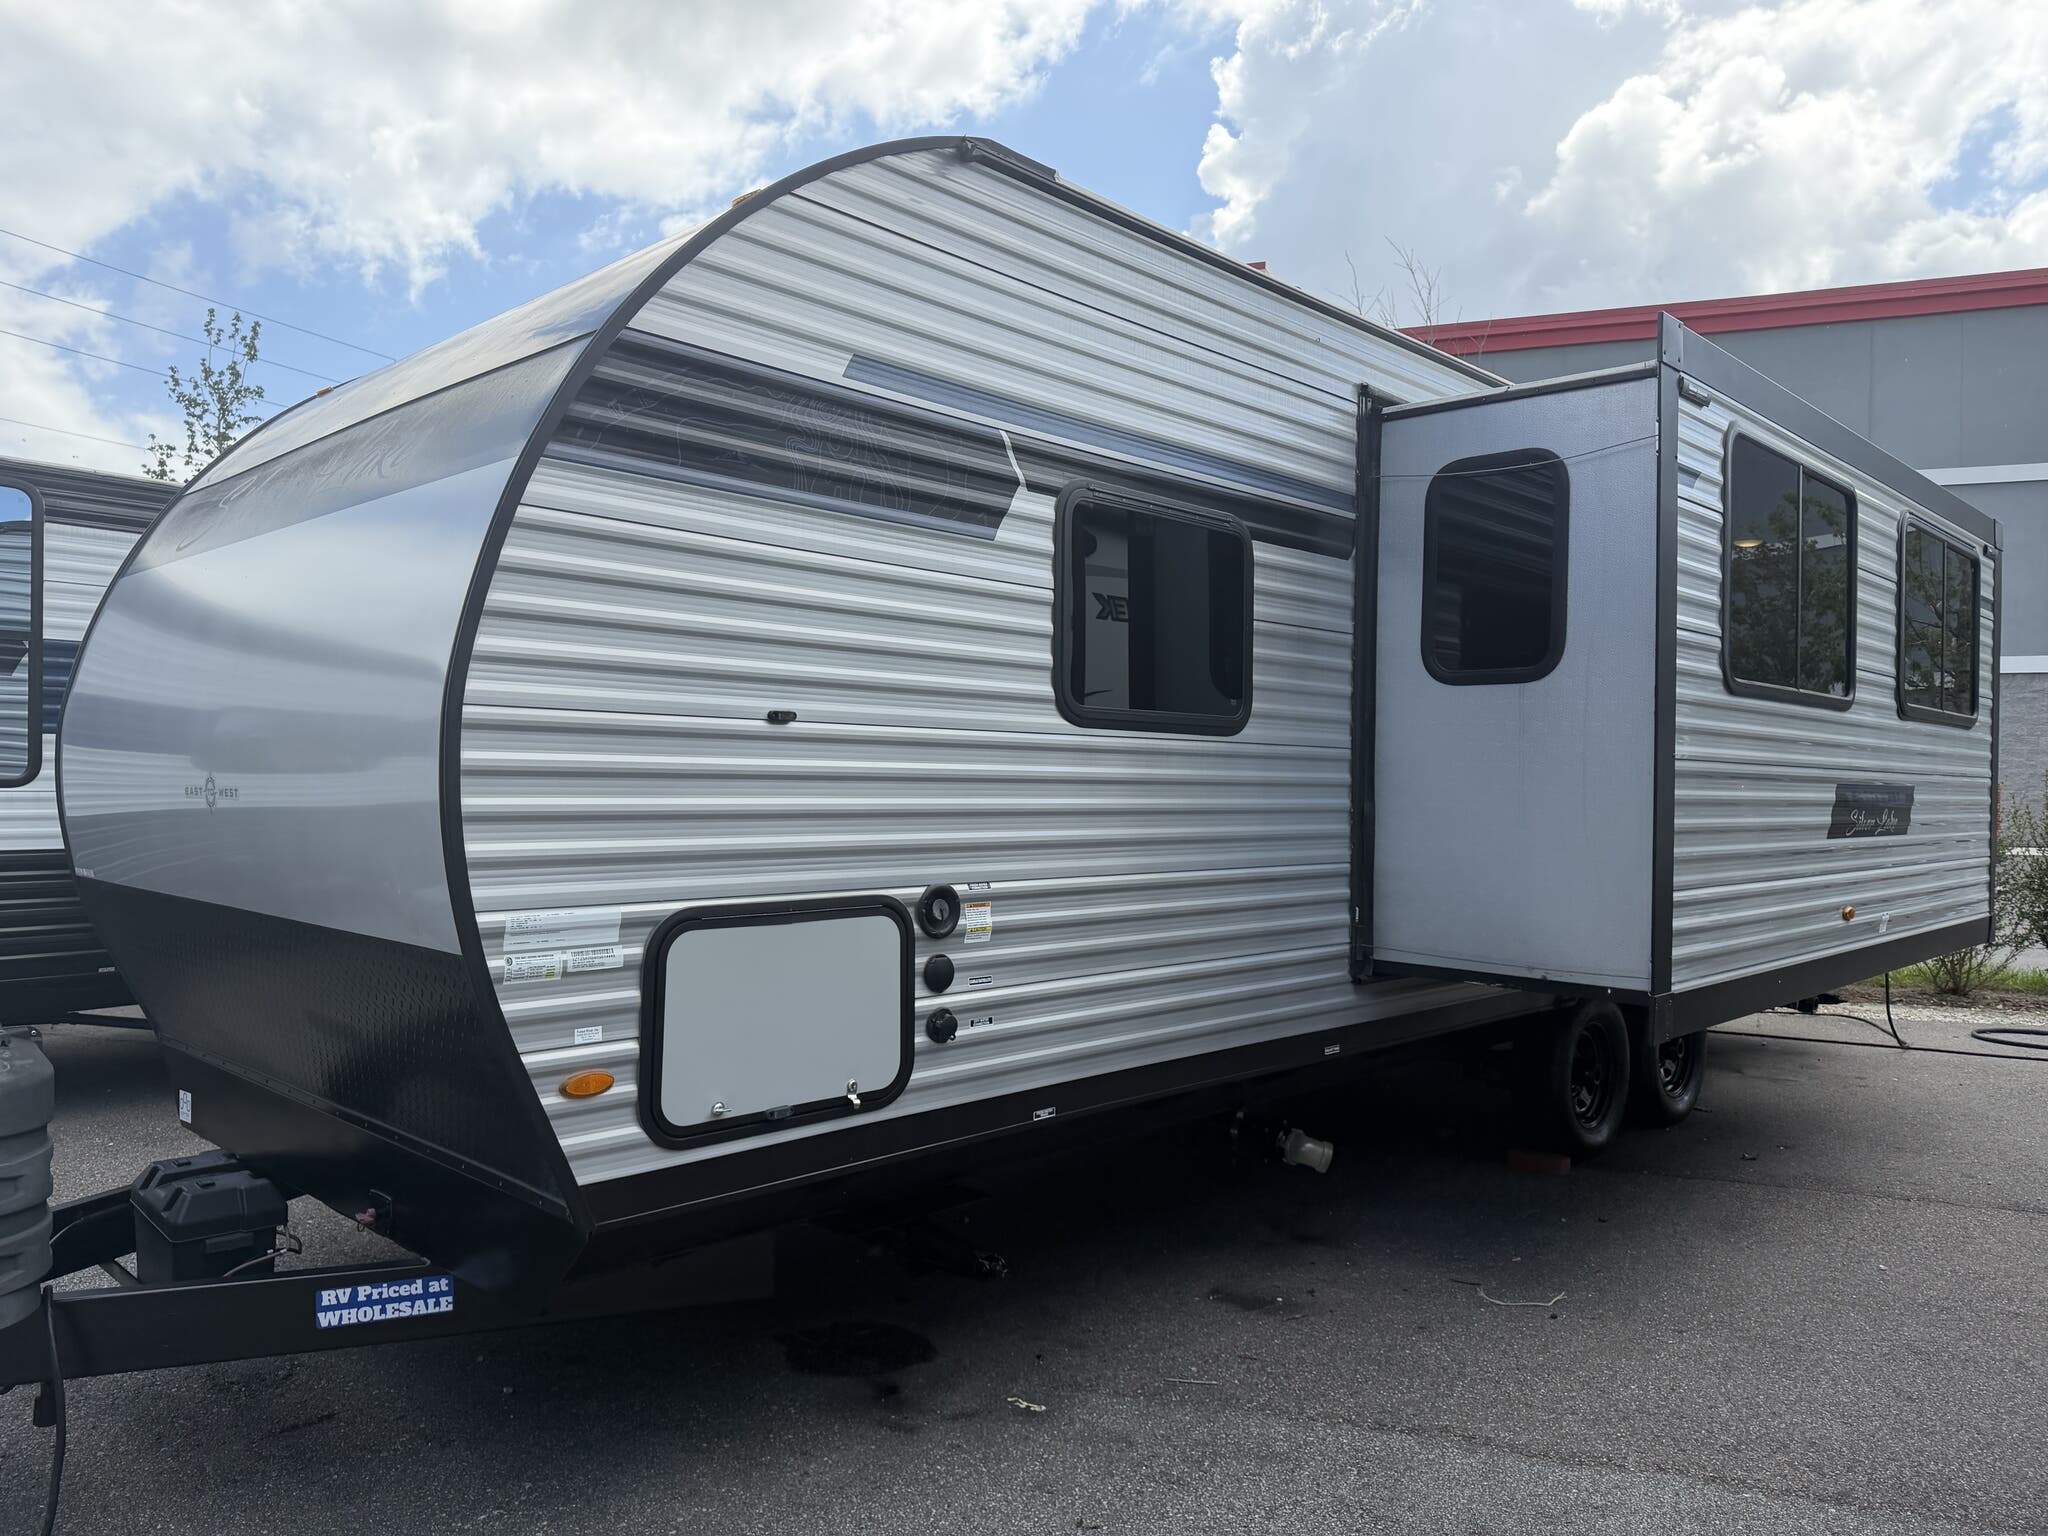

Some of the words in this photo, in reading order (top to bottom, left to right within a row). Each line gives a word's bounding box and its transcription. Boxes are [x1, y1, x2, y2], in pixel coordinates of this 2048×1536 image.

[184, 786, 203, 796] EAST
[218, 788, 239, 798] WEST
[321, 1287, 351, 1306] RV
[357, 1279, 423, 1302] Priced
[428, 1277, 449, 1293] at
[317, 1296, 454, 1328] WHOLESALE
